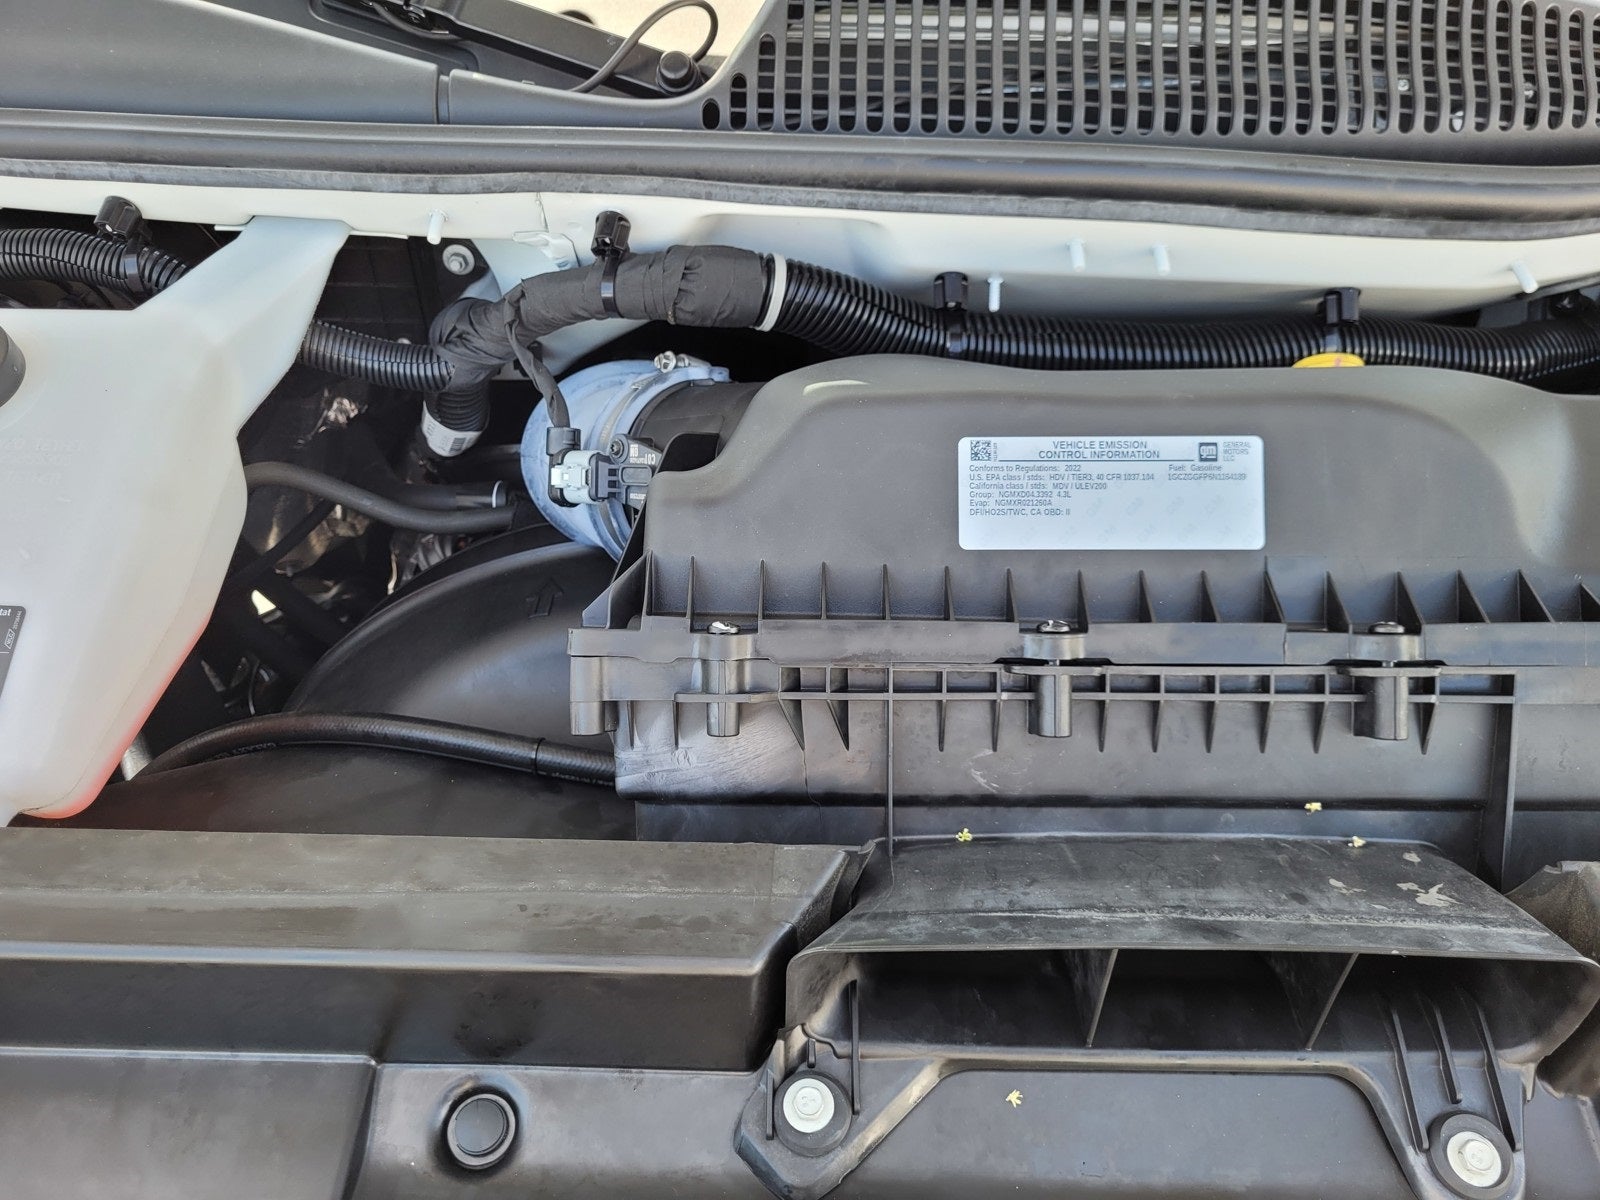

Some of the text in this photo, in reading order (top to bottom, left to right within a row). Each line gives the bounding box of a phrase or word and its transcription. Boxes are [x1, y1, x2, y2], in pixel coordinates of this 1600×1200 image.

[1053, 441, 1147, 449] VEHICLE EMISSION
[1039, 450, 1160, 459] CONTROL INFORMATION
[969, 464, 1081, 474] Conforms to Regulations: 2022
[969, 473, 984, 481] U.S.
[986, 473, 1000, 481] EPA
[1002, 473, 1021, 481] class
[1106, 473, 1122, 481] CFR
[969, 482, 1004, 490] California
[1005, 482, 1024, 490] class
[969, 490, 994, 499] Group:
[969, 499, 990, 508] Evap:
[1030, 508, 1041, 516] CA
